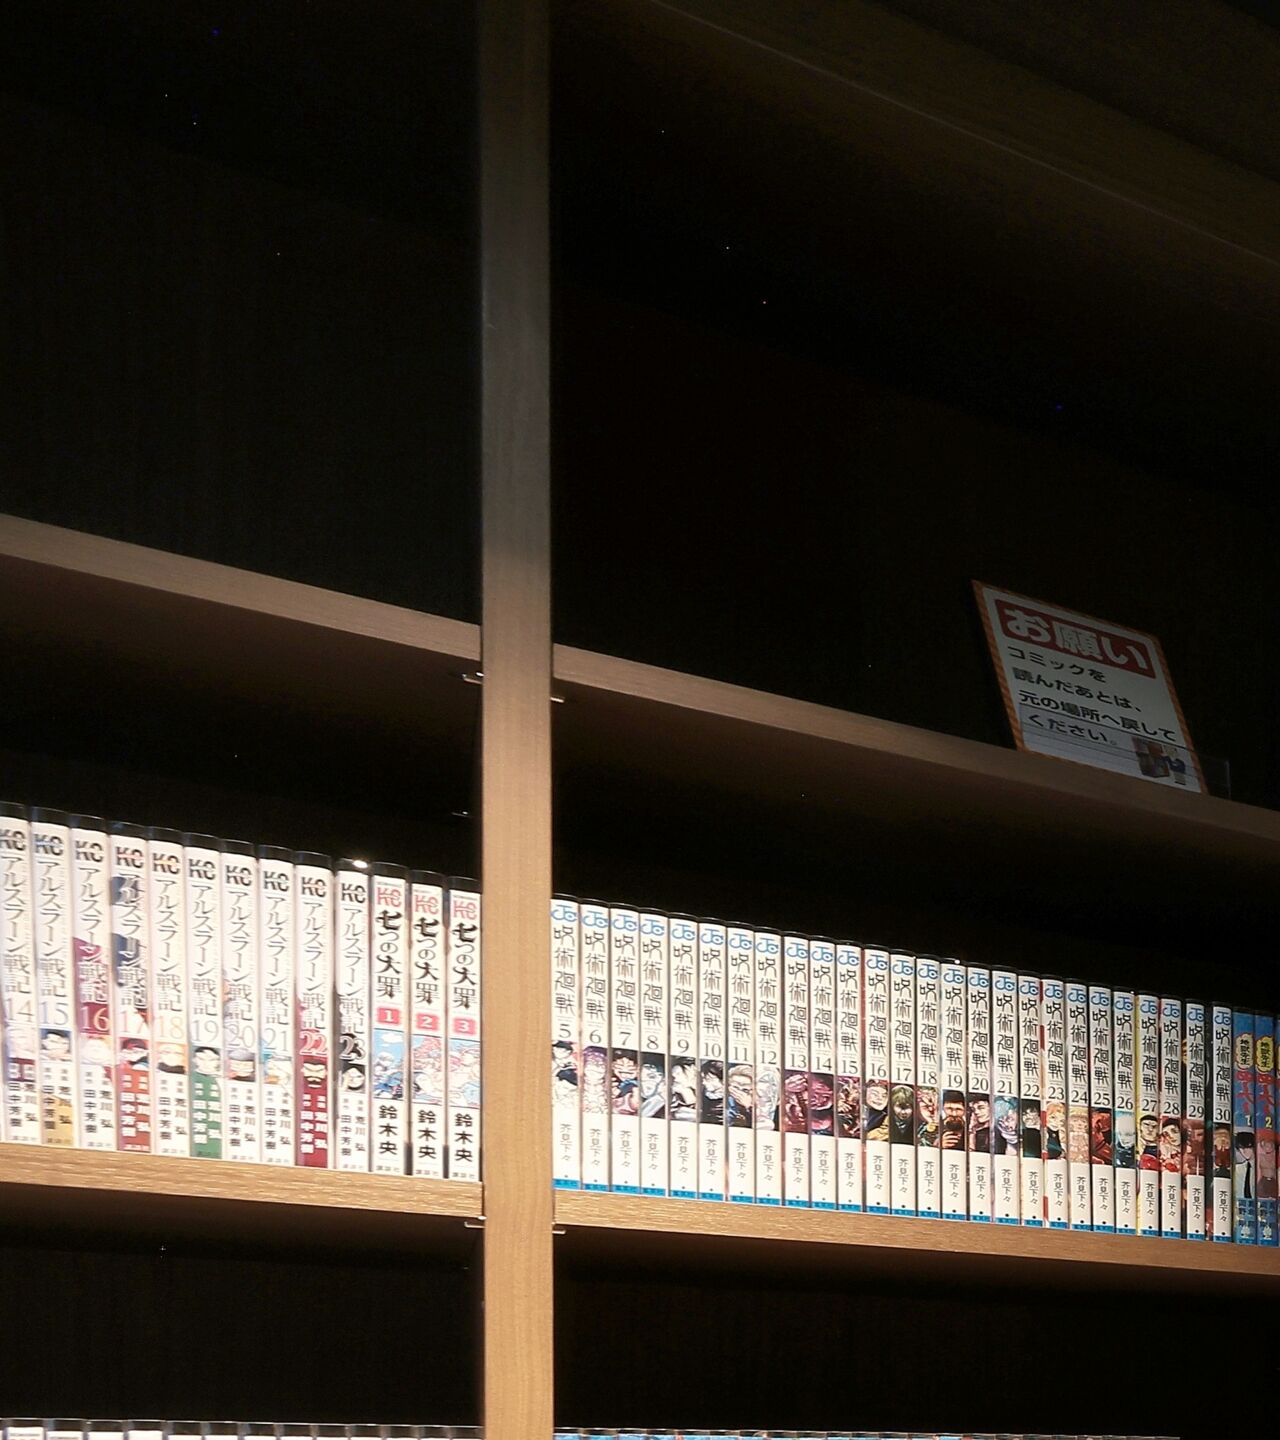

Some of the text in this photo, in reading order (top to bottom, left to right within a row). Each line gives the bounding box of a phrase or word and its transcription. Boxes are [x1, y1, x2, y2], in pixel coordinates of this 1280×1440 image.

[1004, 608, 1146, 670] お願い
[1007, 646, 1106, 683] コミックを
[1013, 668, 1142, 713] 読んだあとは、
[1019, 689, 1176, 742] 元の場所へ戻して
[1029, 715, 1118, 746] ください。
[38, 860, 70, 1026] アルスラーン戦記 15
[191, 884, 220, 1044] アルスラーン戦記 19
[263, 895, 291, 1053] アルスラーン戦記 21
[299, 900, 328, 1056] アルスラーン戦記 22
[414, 916, 441, 1030] 七つの大罪 2
[452, 921, 479, 1034] 七つの大罪 3
[554, 925, 576, 1038] 呪術廻戦 5
[376, 911, 404, 1156] 七つの大罪 1 鈴木央
[620, 1031, 631, 1046] 7
[703, 947, 723, 1058] 呪術廻戦 10
[816, 1056, 833, 1071] 14
[1047, 1085, 1066, 1101] 23
[1093, 1010, 1110, 1106] 呪術廻戦 25
[1215, 1027, 1231, 1122] 呪術廻戦 30
